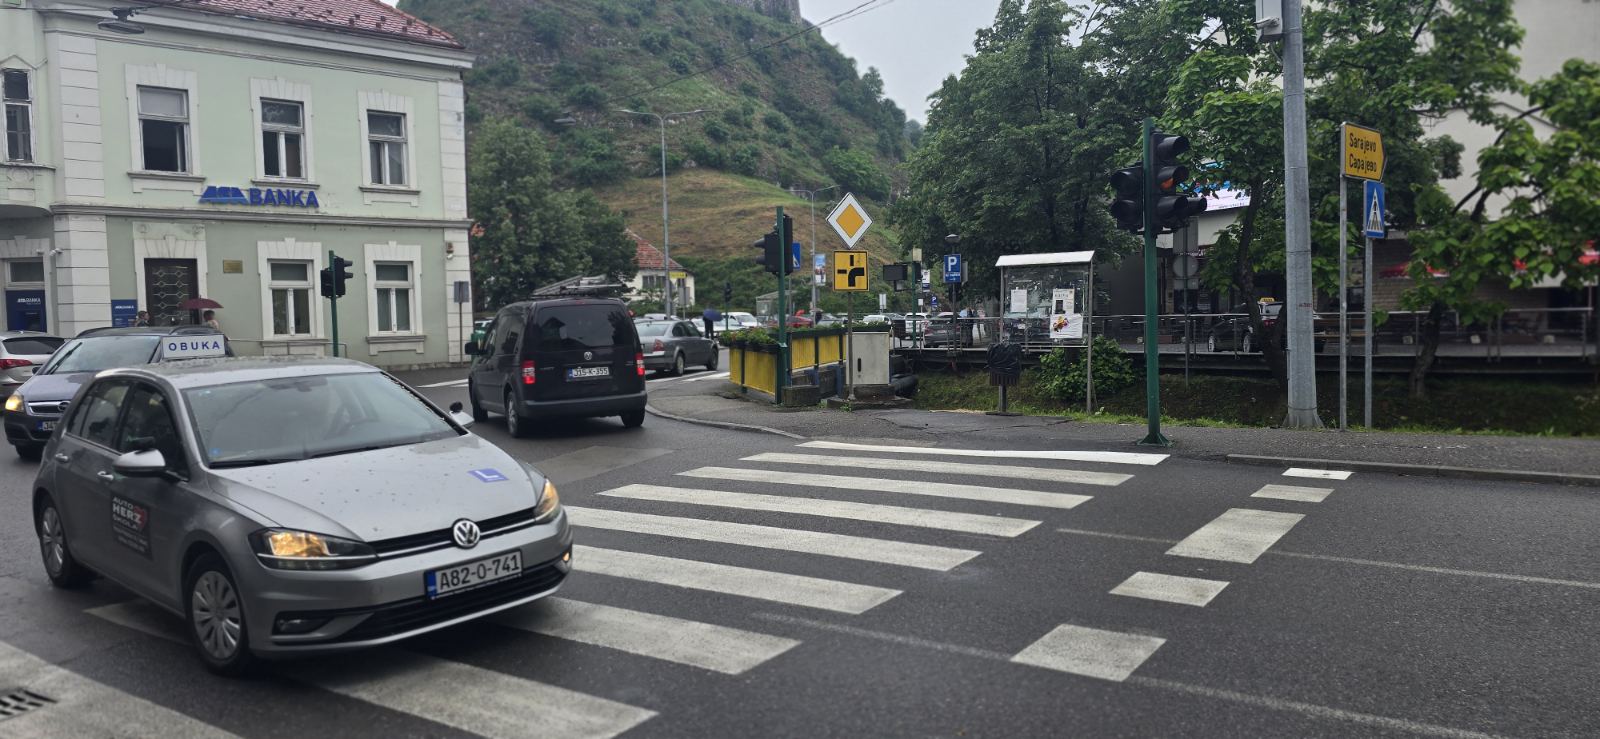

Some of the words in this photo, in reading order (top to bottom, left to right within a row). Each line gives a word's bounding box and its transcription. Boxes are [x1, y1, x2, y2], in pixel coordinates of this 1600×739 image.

[1349, 132, 1377, 154] Sarajevo
[1349, 153, 1377, 174] Сарајево
[249, 187, 319, 208] BANKA
[948, 256, 957, 271] P
[168, 340, 220, 351] OBUKA
[112, 503, 142, 524] HERZ
